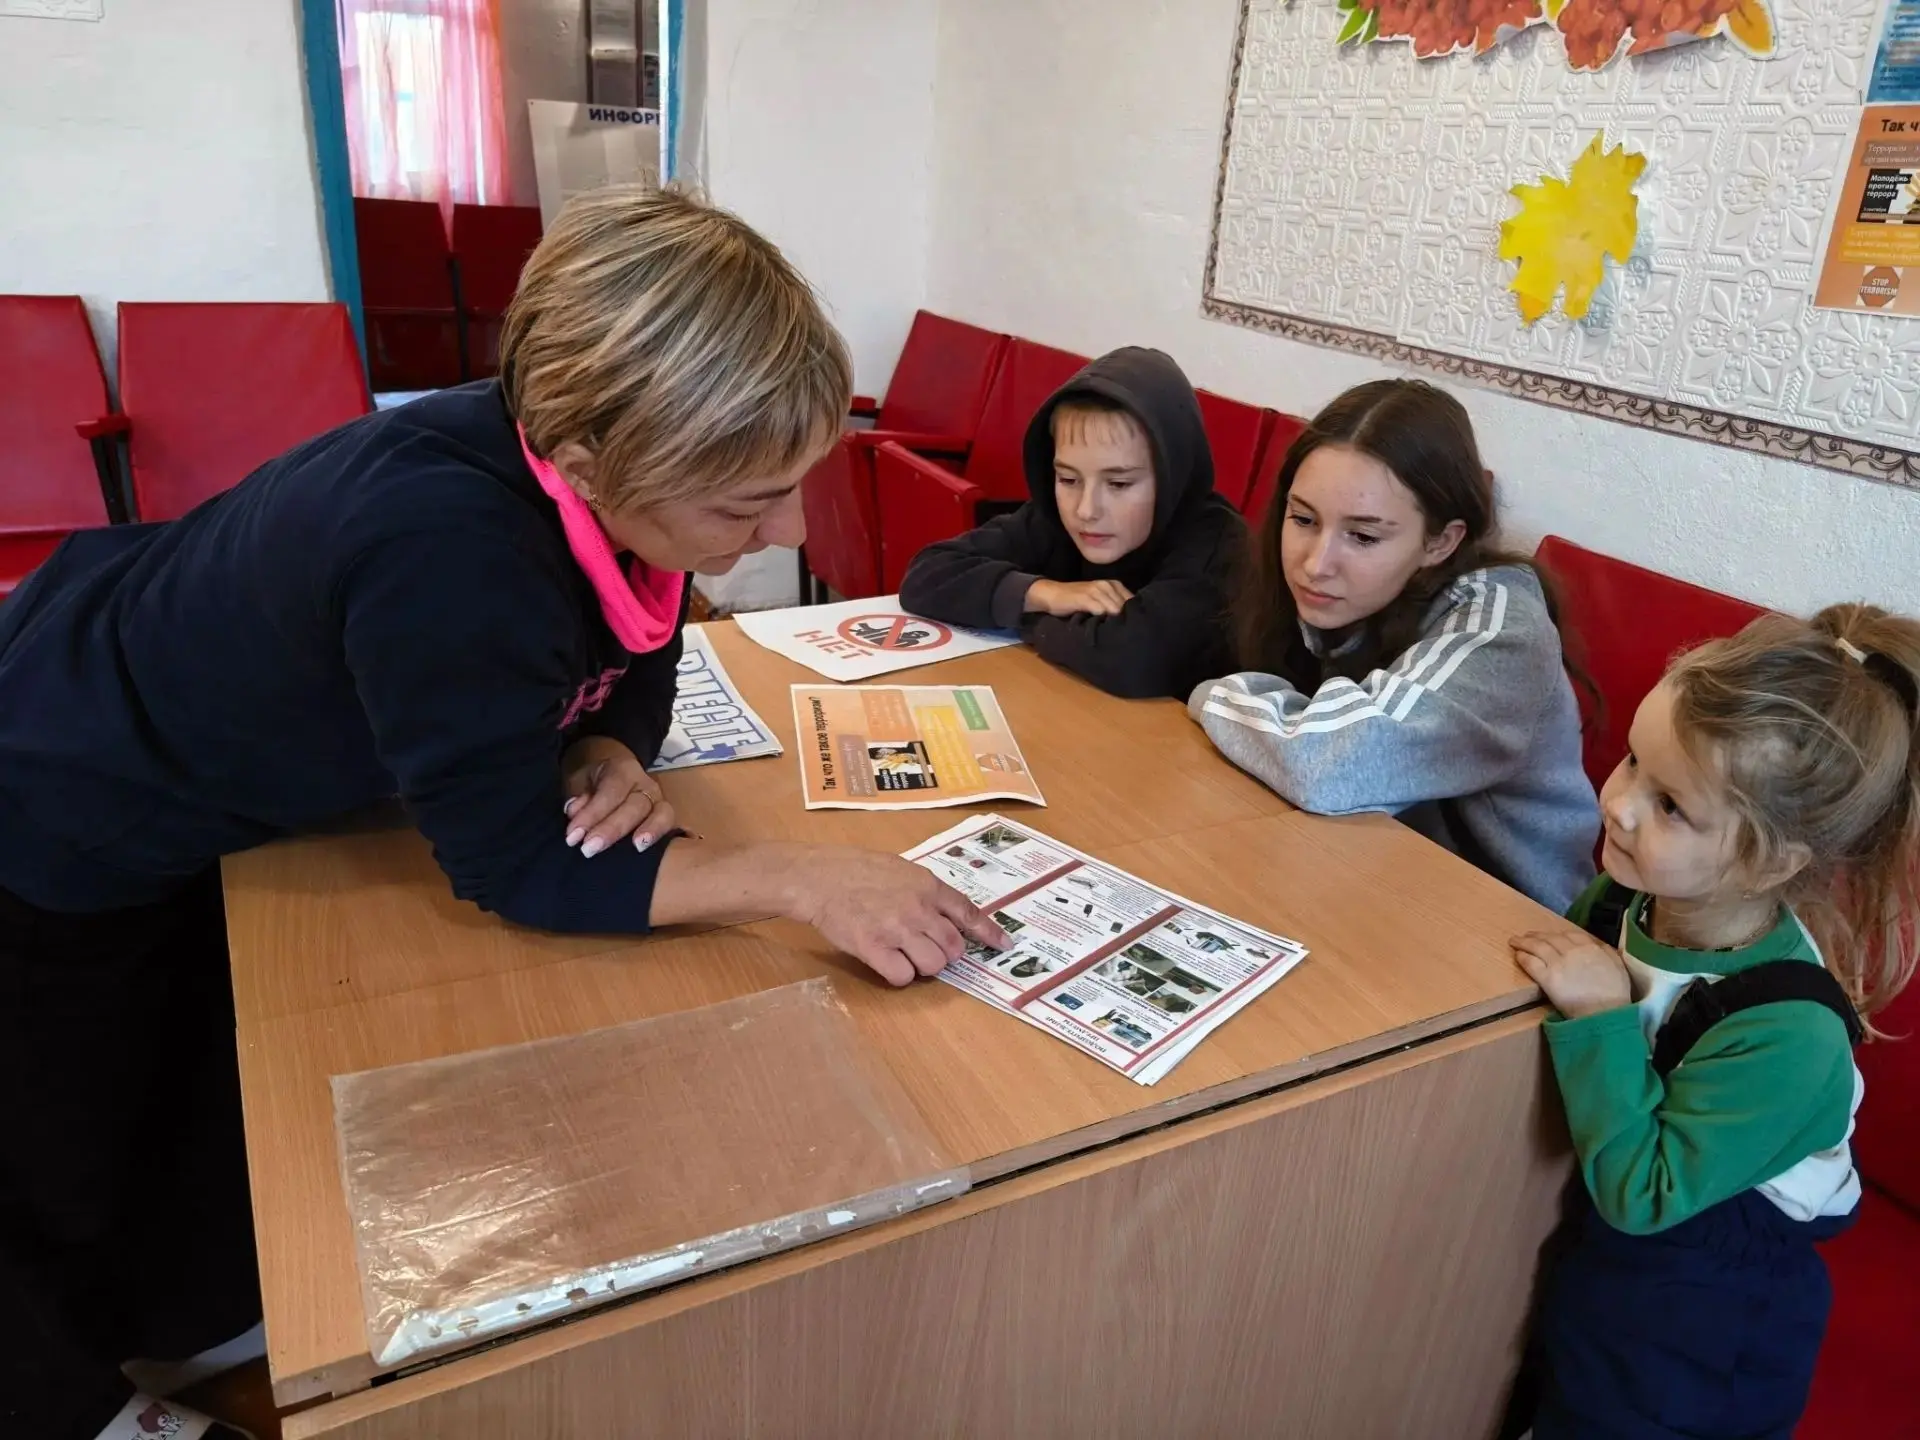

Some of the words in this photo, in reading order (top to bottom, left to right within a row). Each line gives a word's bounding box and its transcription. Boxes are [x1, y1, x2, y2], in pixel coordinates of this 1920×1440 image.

[1881, 119, 1906, 132] Так
[1910, 123, 1920, 132] ч
[1872, 278, 1889, 286] STOP
[1860, 286, 1898, 295] TERRORISM
[793, 630, 874, 659] НЕТ
[817, 732, 830, 751] такое
[820, 752, 831, 762] же
[822, 763, 833, 776] что
[822, 777, 837, 791] Так
